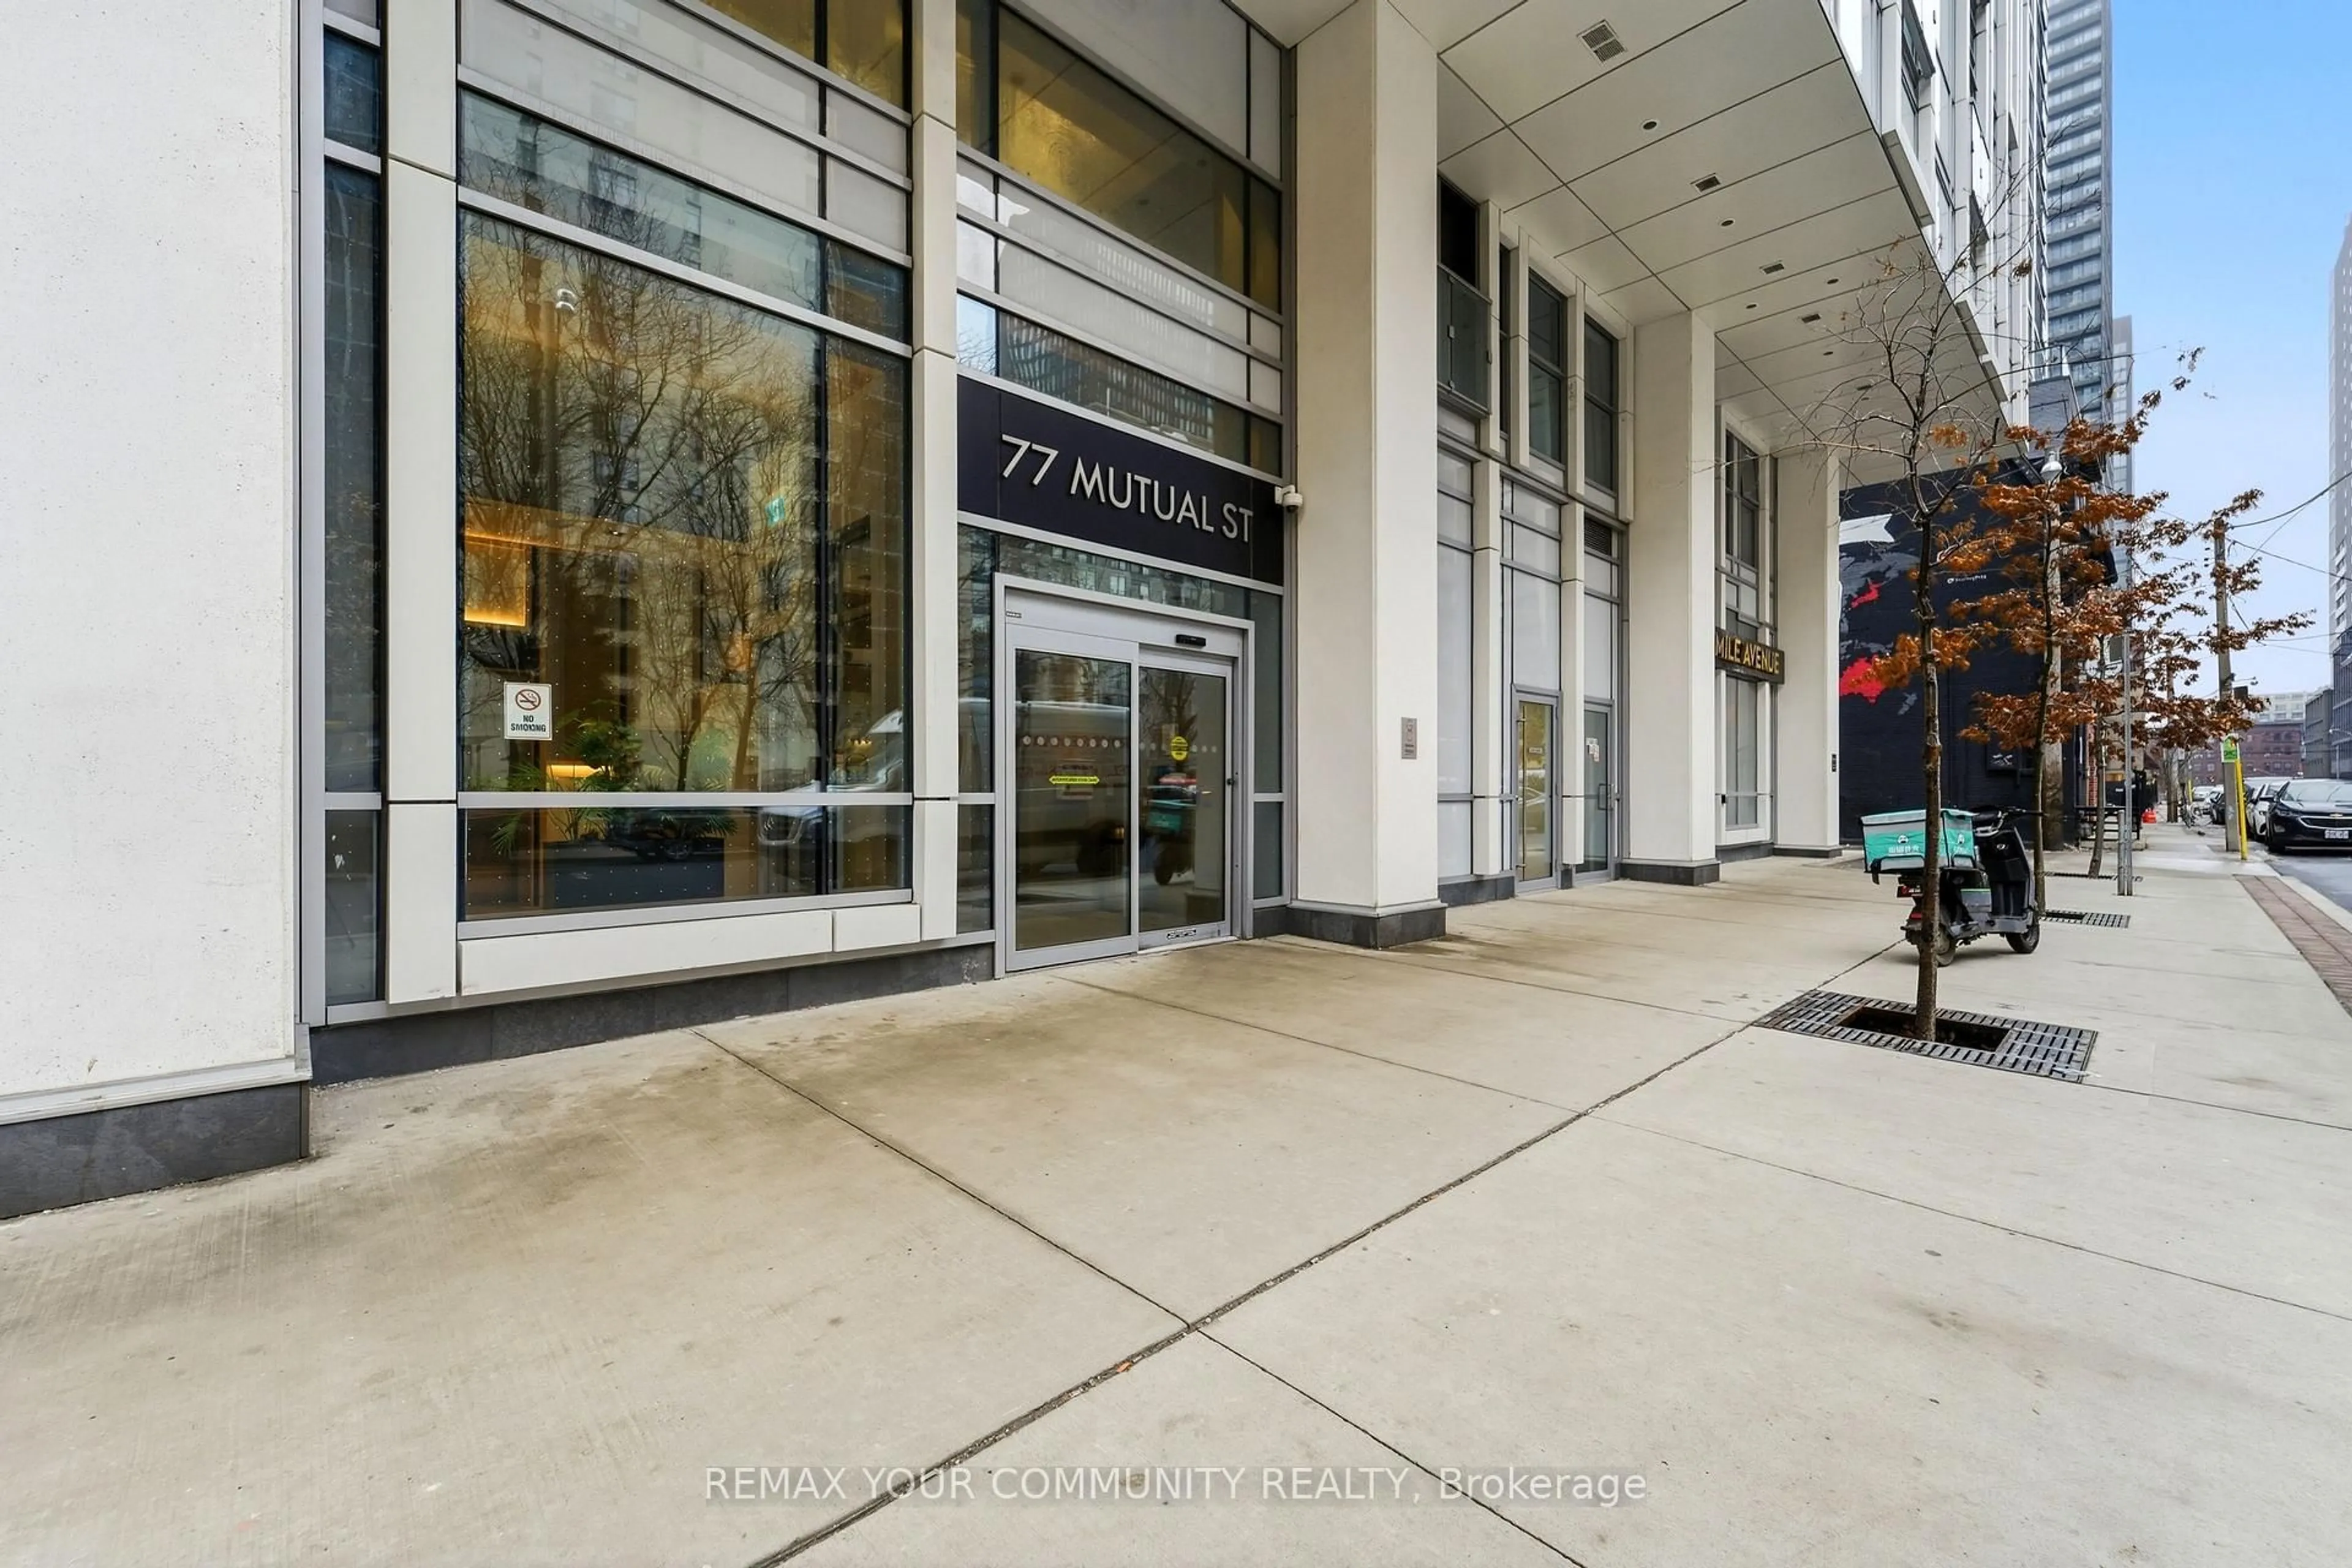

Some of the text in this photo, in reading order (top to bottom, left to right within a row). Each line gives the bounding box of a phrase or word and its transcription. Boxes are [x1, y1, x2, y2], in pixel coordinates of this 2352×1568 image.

[1002, 434, 1254, 543] 77 MUTUAL ST
[1743, 641, 1780, 674] AVENUE
[511, 723, 546, 733] SMOKING
